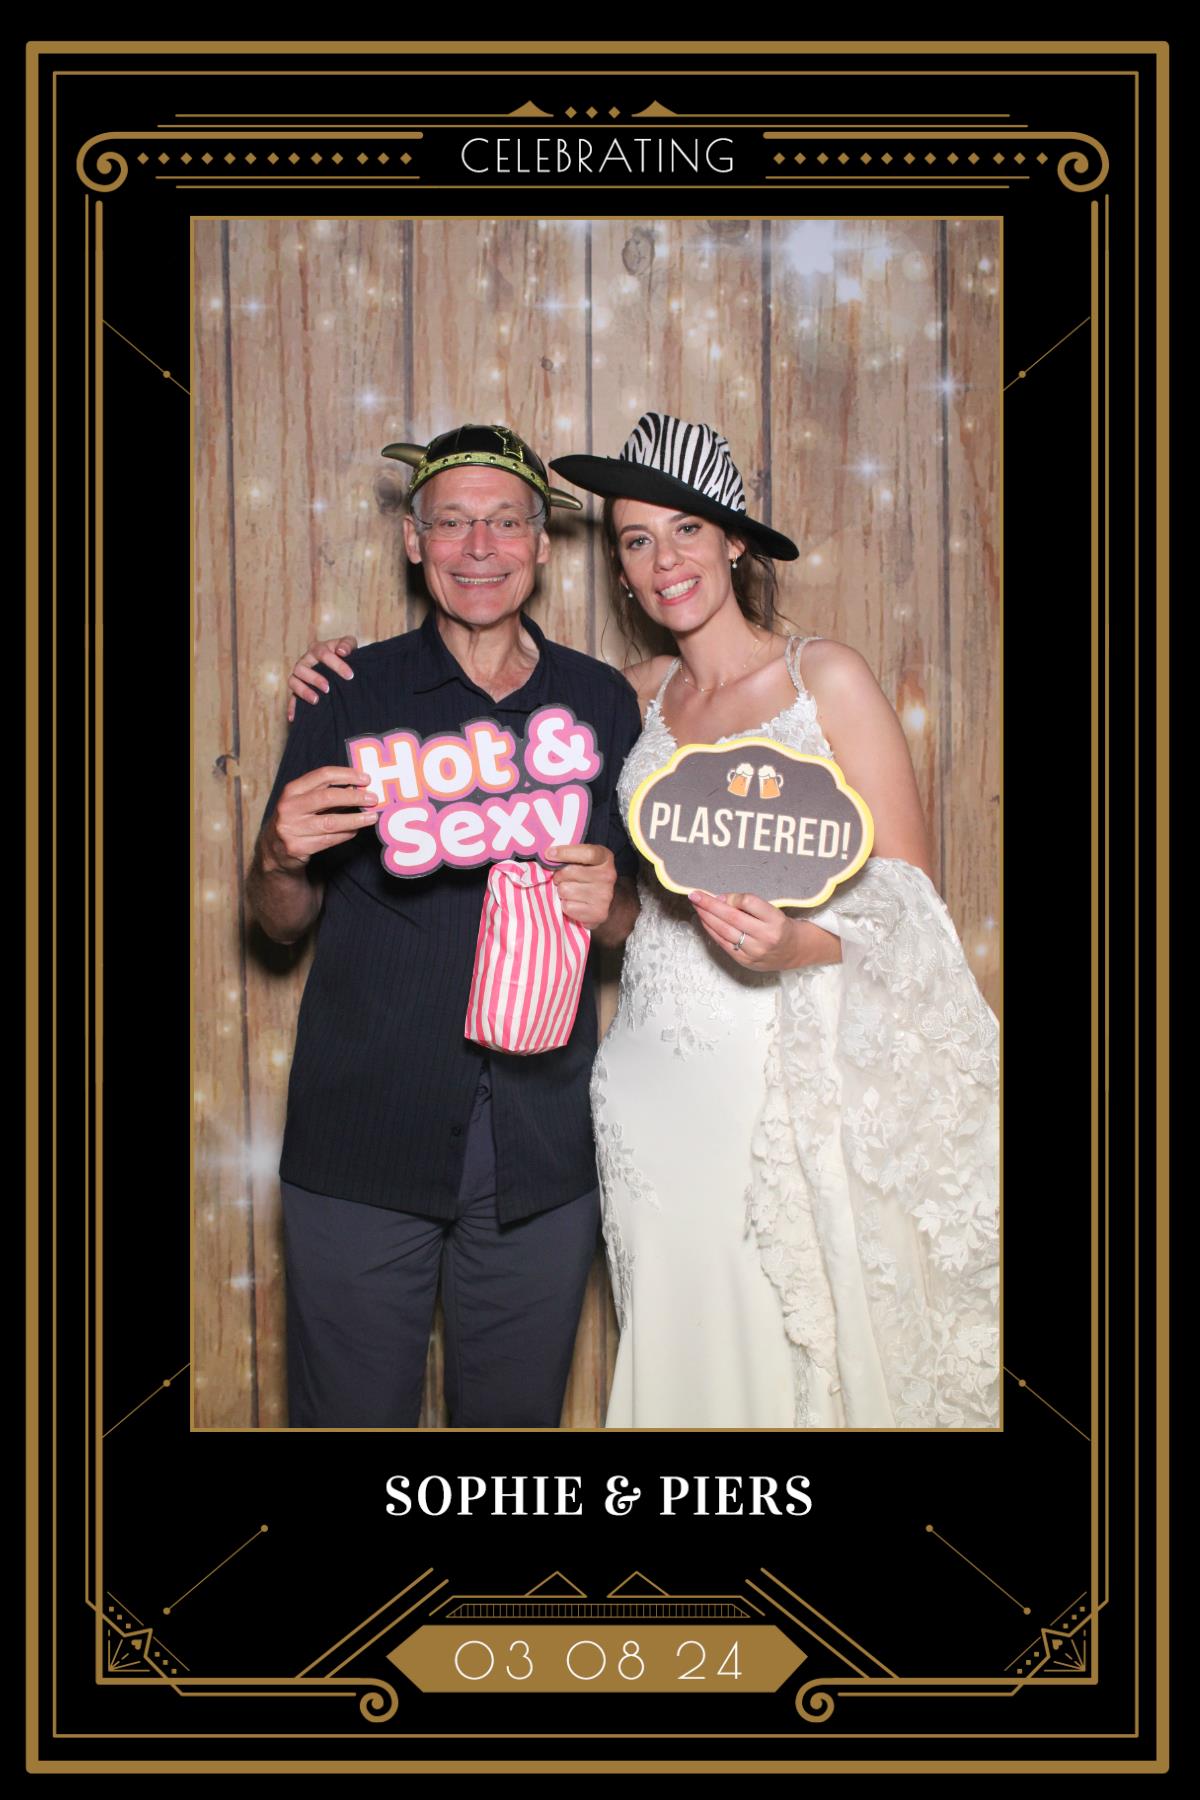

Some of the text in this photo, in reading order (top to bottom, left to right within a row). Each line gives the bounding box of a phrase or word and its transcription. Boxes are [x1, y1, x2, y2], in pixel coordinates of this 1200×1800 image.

[359, 717, 592, 804] Hot &
[387, 792, 580, 867] Sexy
[648, 801, 851, 860] PLASTERED!
